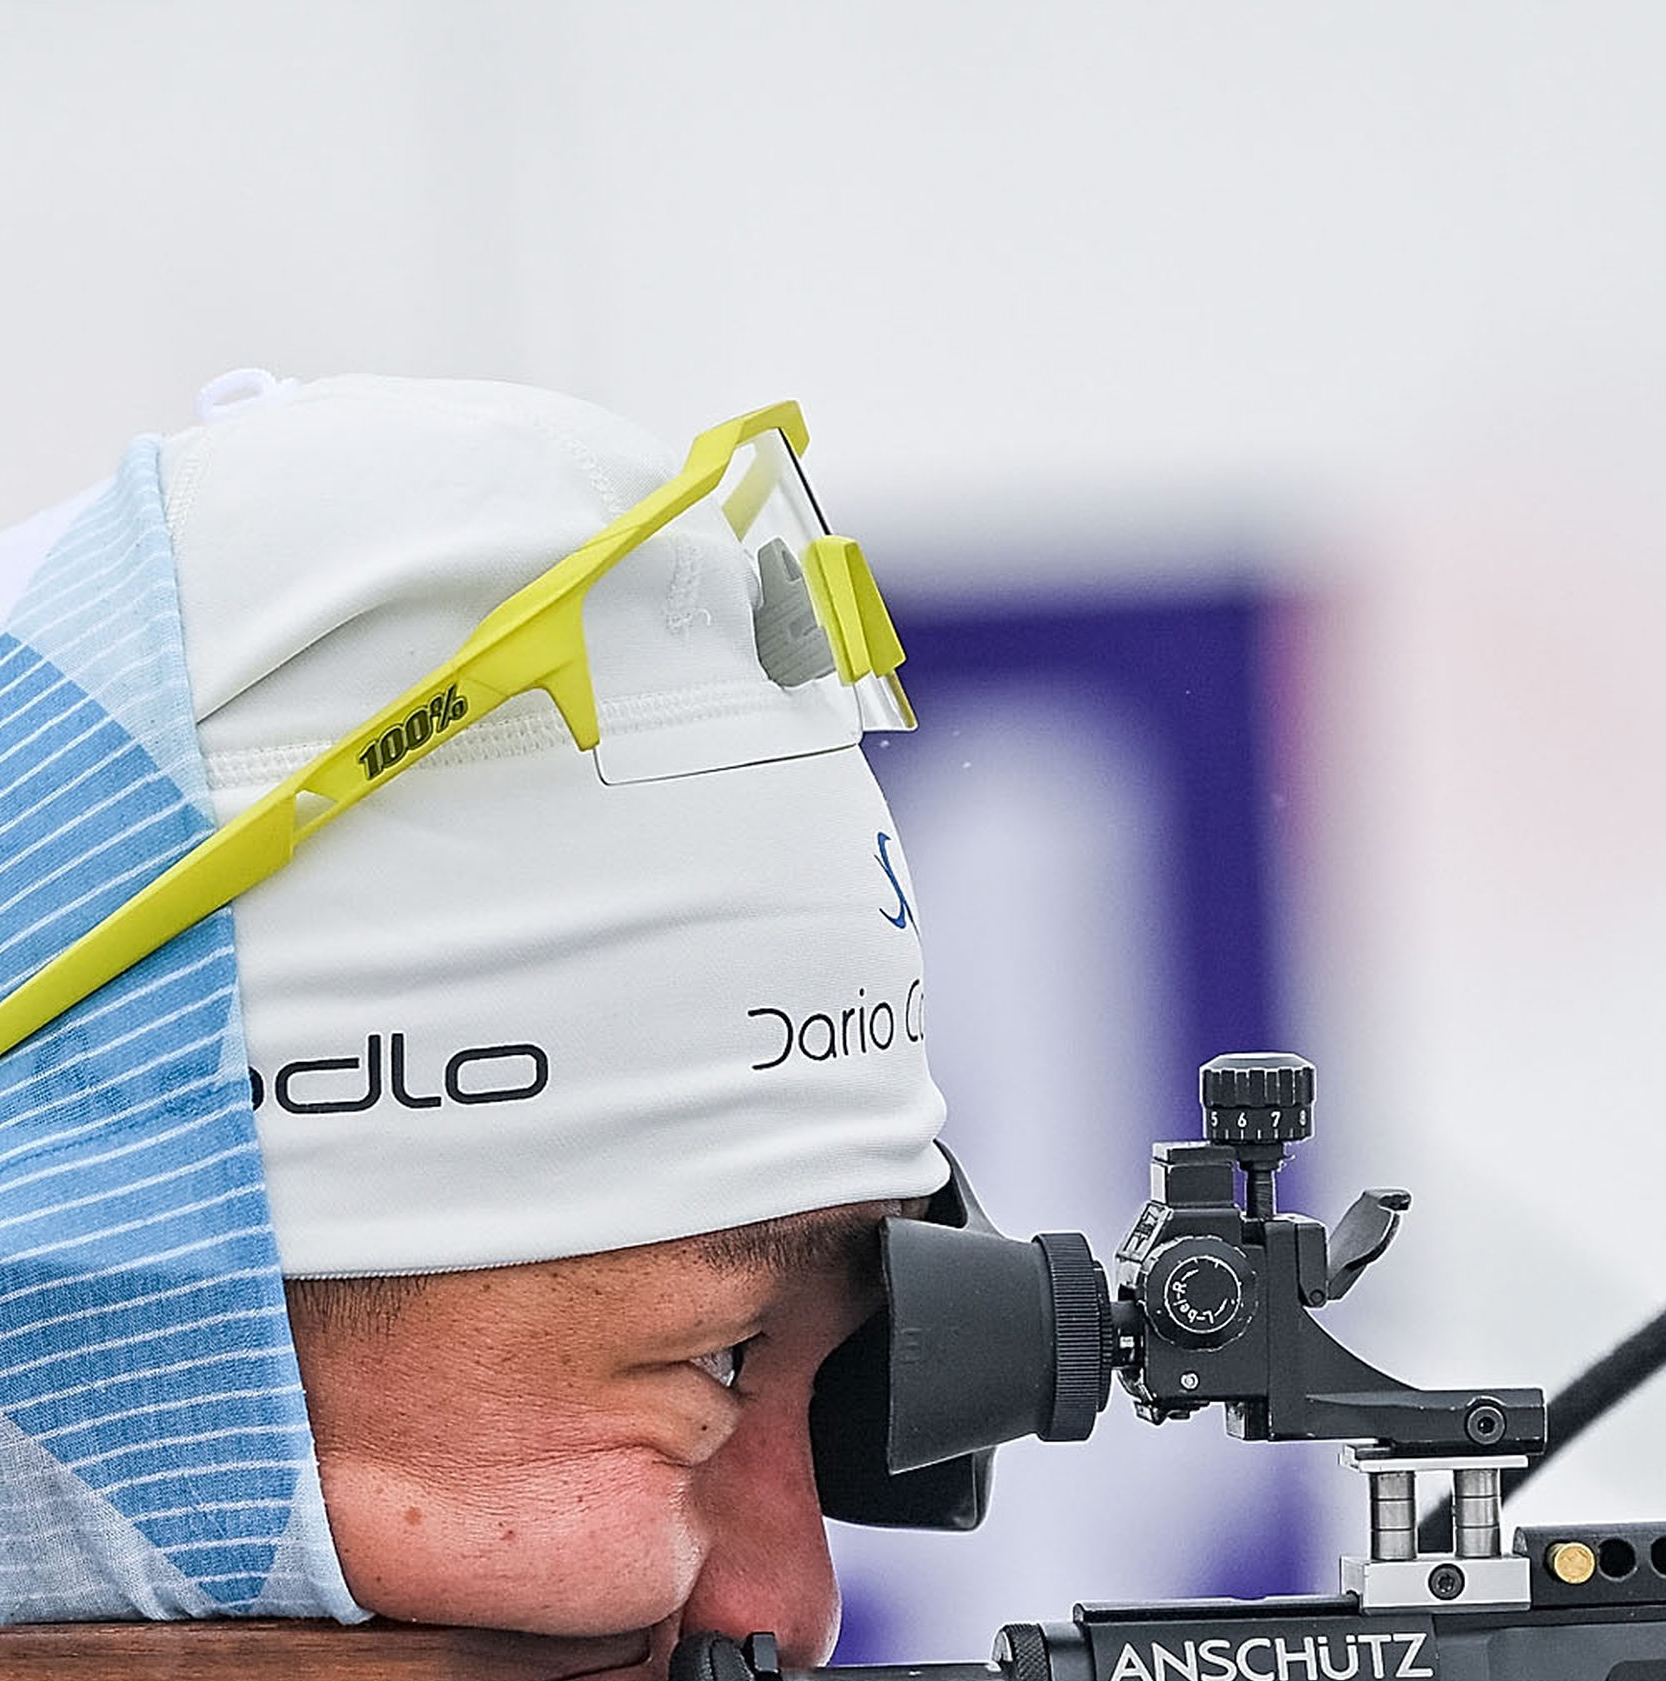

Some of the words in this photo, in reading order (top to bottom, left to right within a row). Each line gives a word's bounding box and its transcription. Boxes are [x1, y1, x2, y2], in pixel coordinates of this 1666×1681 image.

[357, 683, 469, 780] 100%
[747, 986, 894, 1070] Dario
[248, 1033, 548, 1115] dlo
[1211, 1111, 1219, 1127] 5
[1237, 1112, 1248, 1128] 6
[1271, 1111, 1282, 1128] 7
